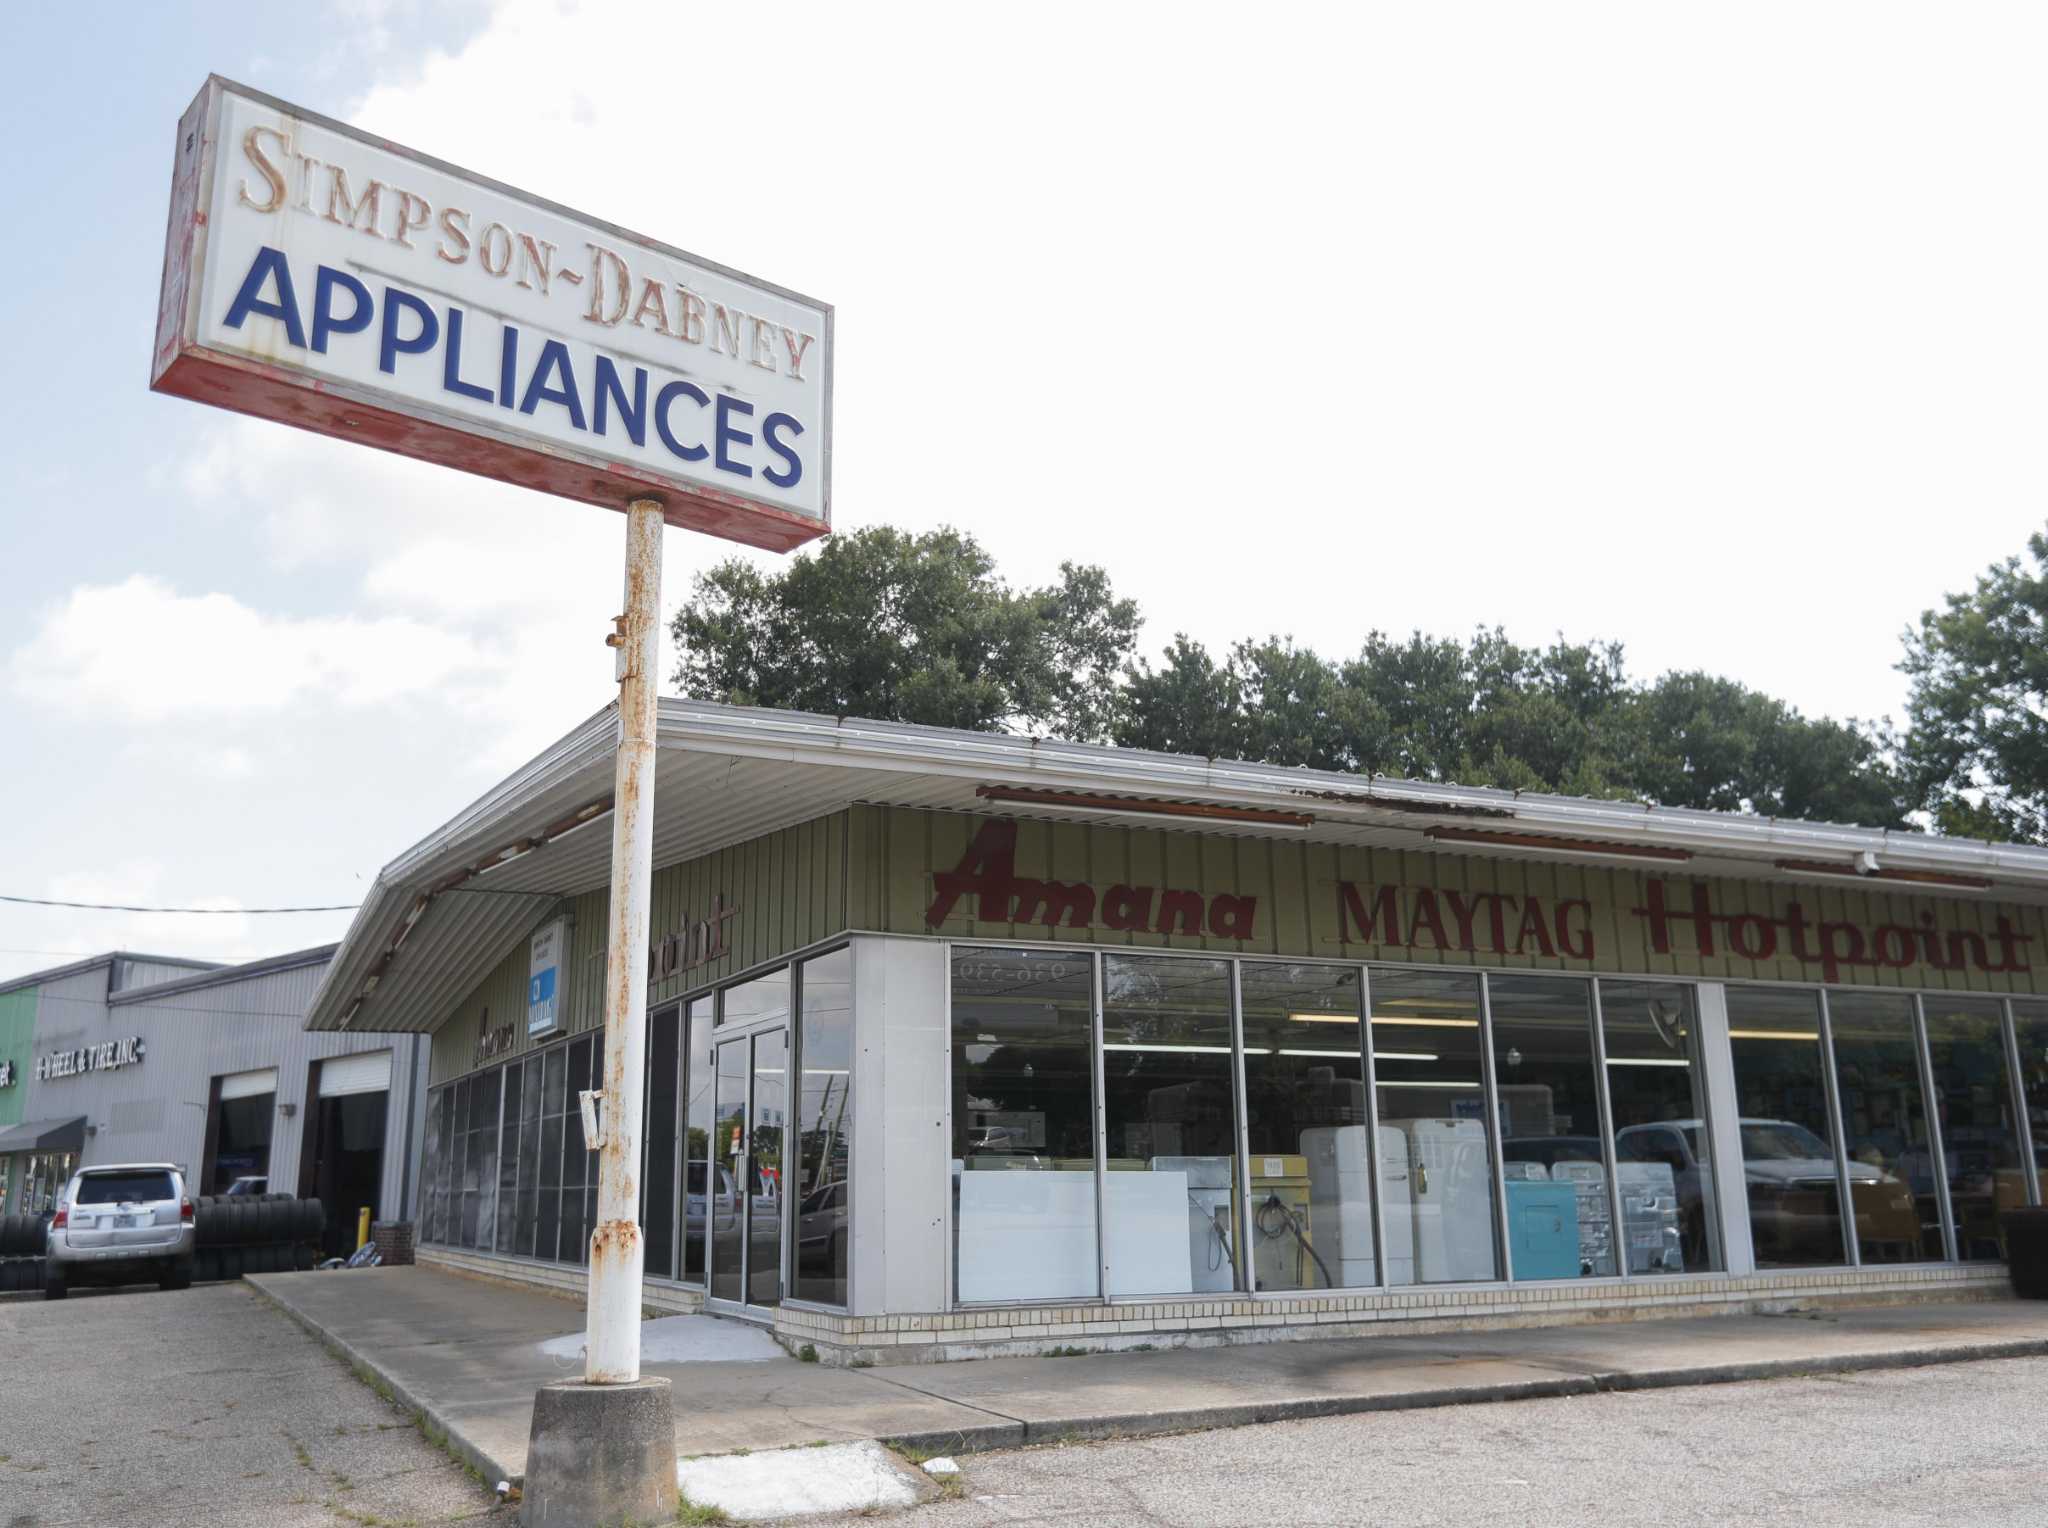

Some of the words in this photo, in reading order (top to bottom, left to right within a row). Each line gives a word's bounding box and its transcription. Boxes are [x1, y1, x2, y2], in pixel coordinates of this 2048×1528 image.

[223, 245, 805, 489] APPLIANCES
[925, 816, 1257, 940] Amana
[1336, 879, 1595, 960] MAYTAG
[1631, 878, 2034, 984] Hotpoint
